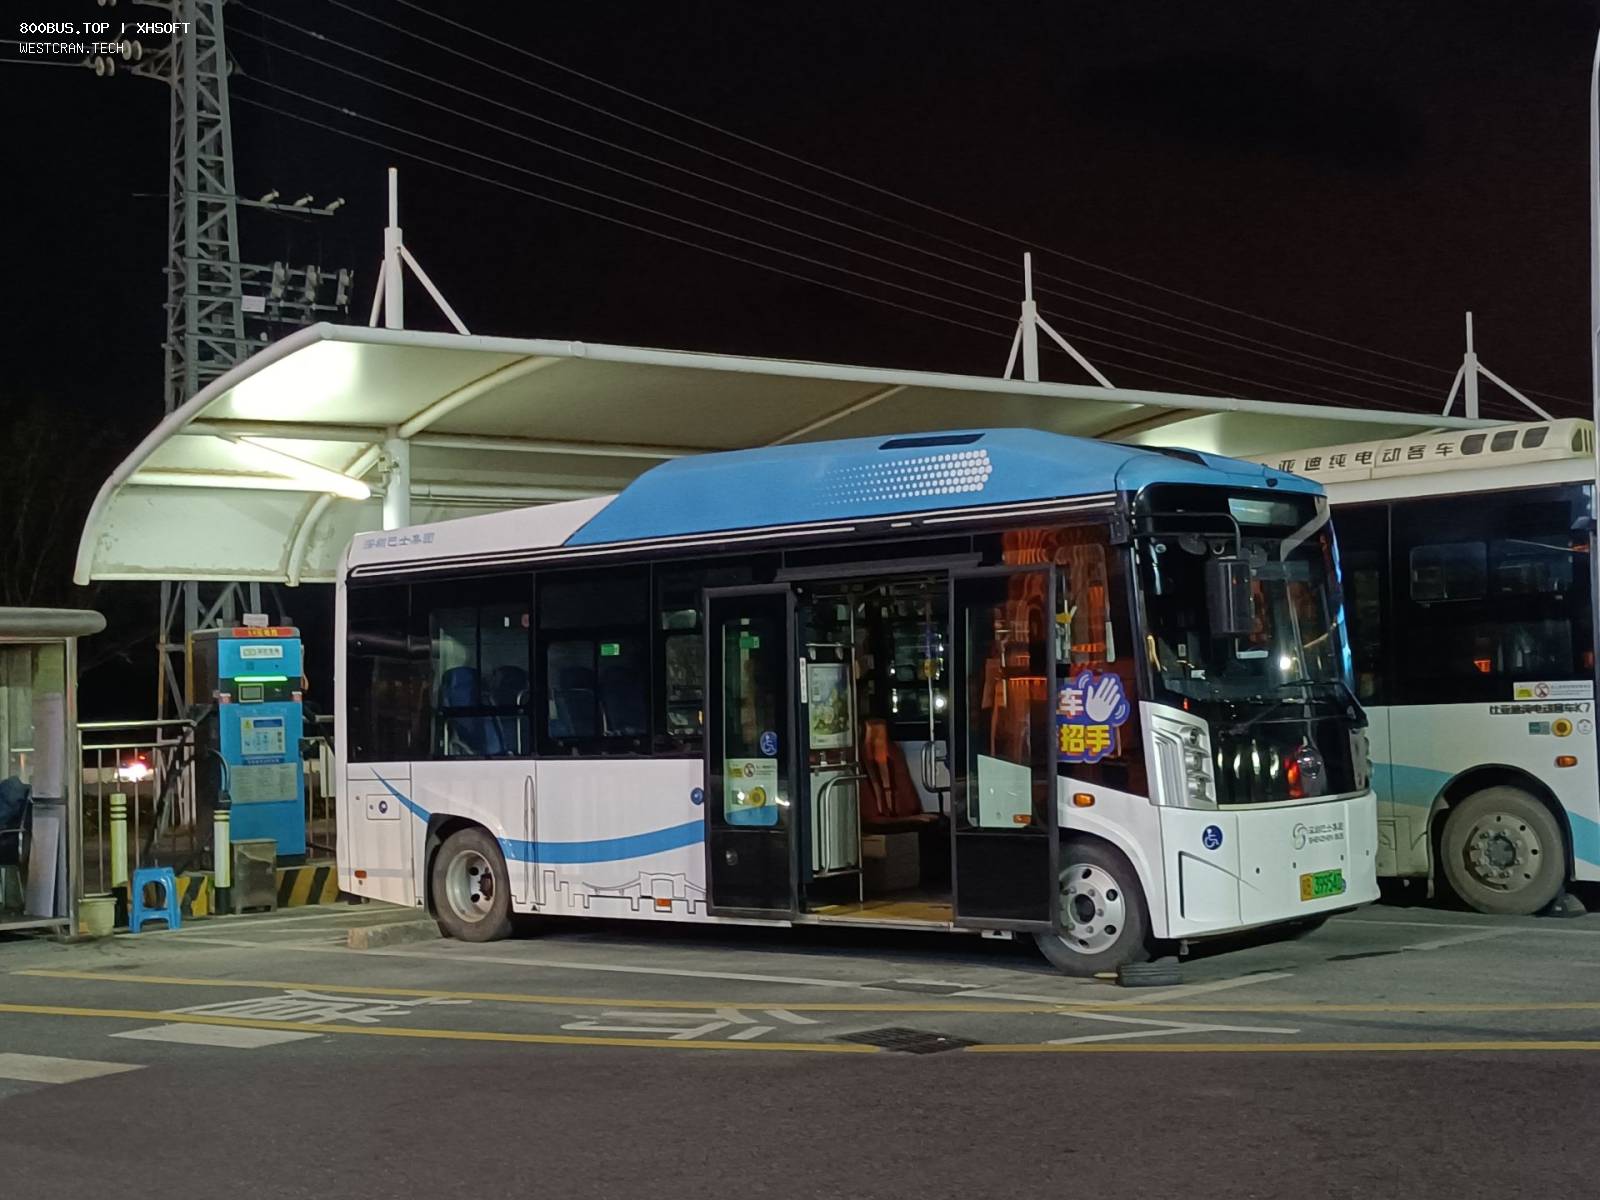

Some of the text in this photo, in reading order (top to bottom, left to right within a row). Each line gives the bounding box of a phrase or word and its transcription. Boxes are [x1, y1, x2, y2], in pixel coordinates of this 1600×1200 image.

[1261, 443, 1455, 473] 亚迪纯电动客车
[1060, 723, 1111, 753] 招手
